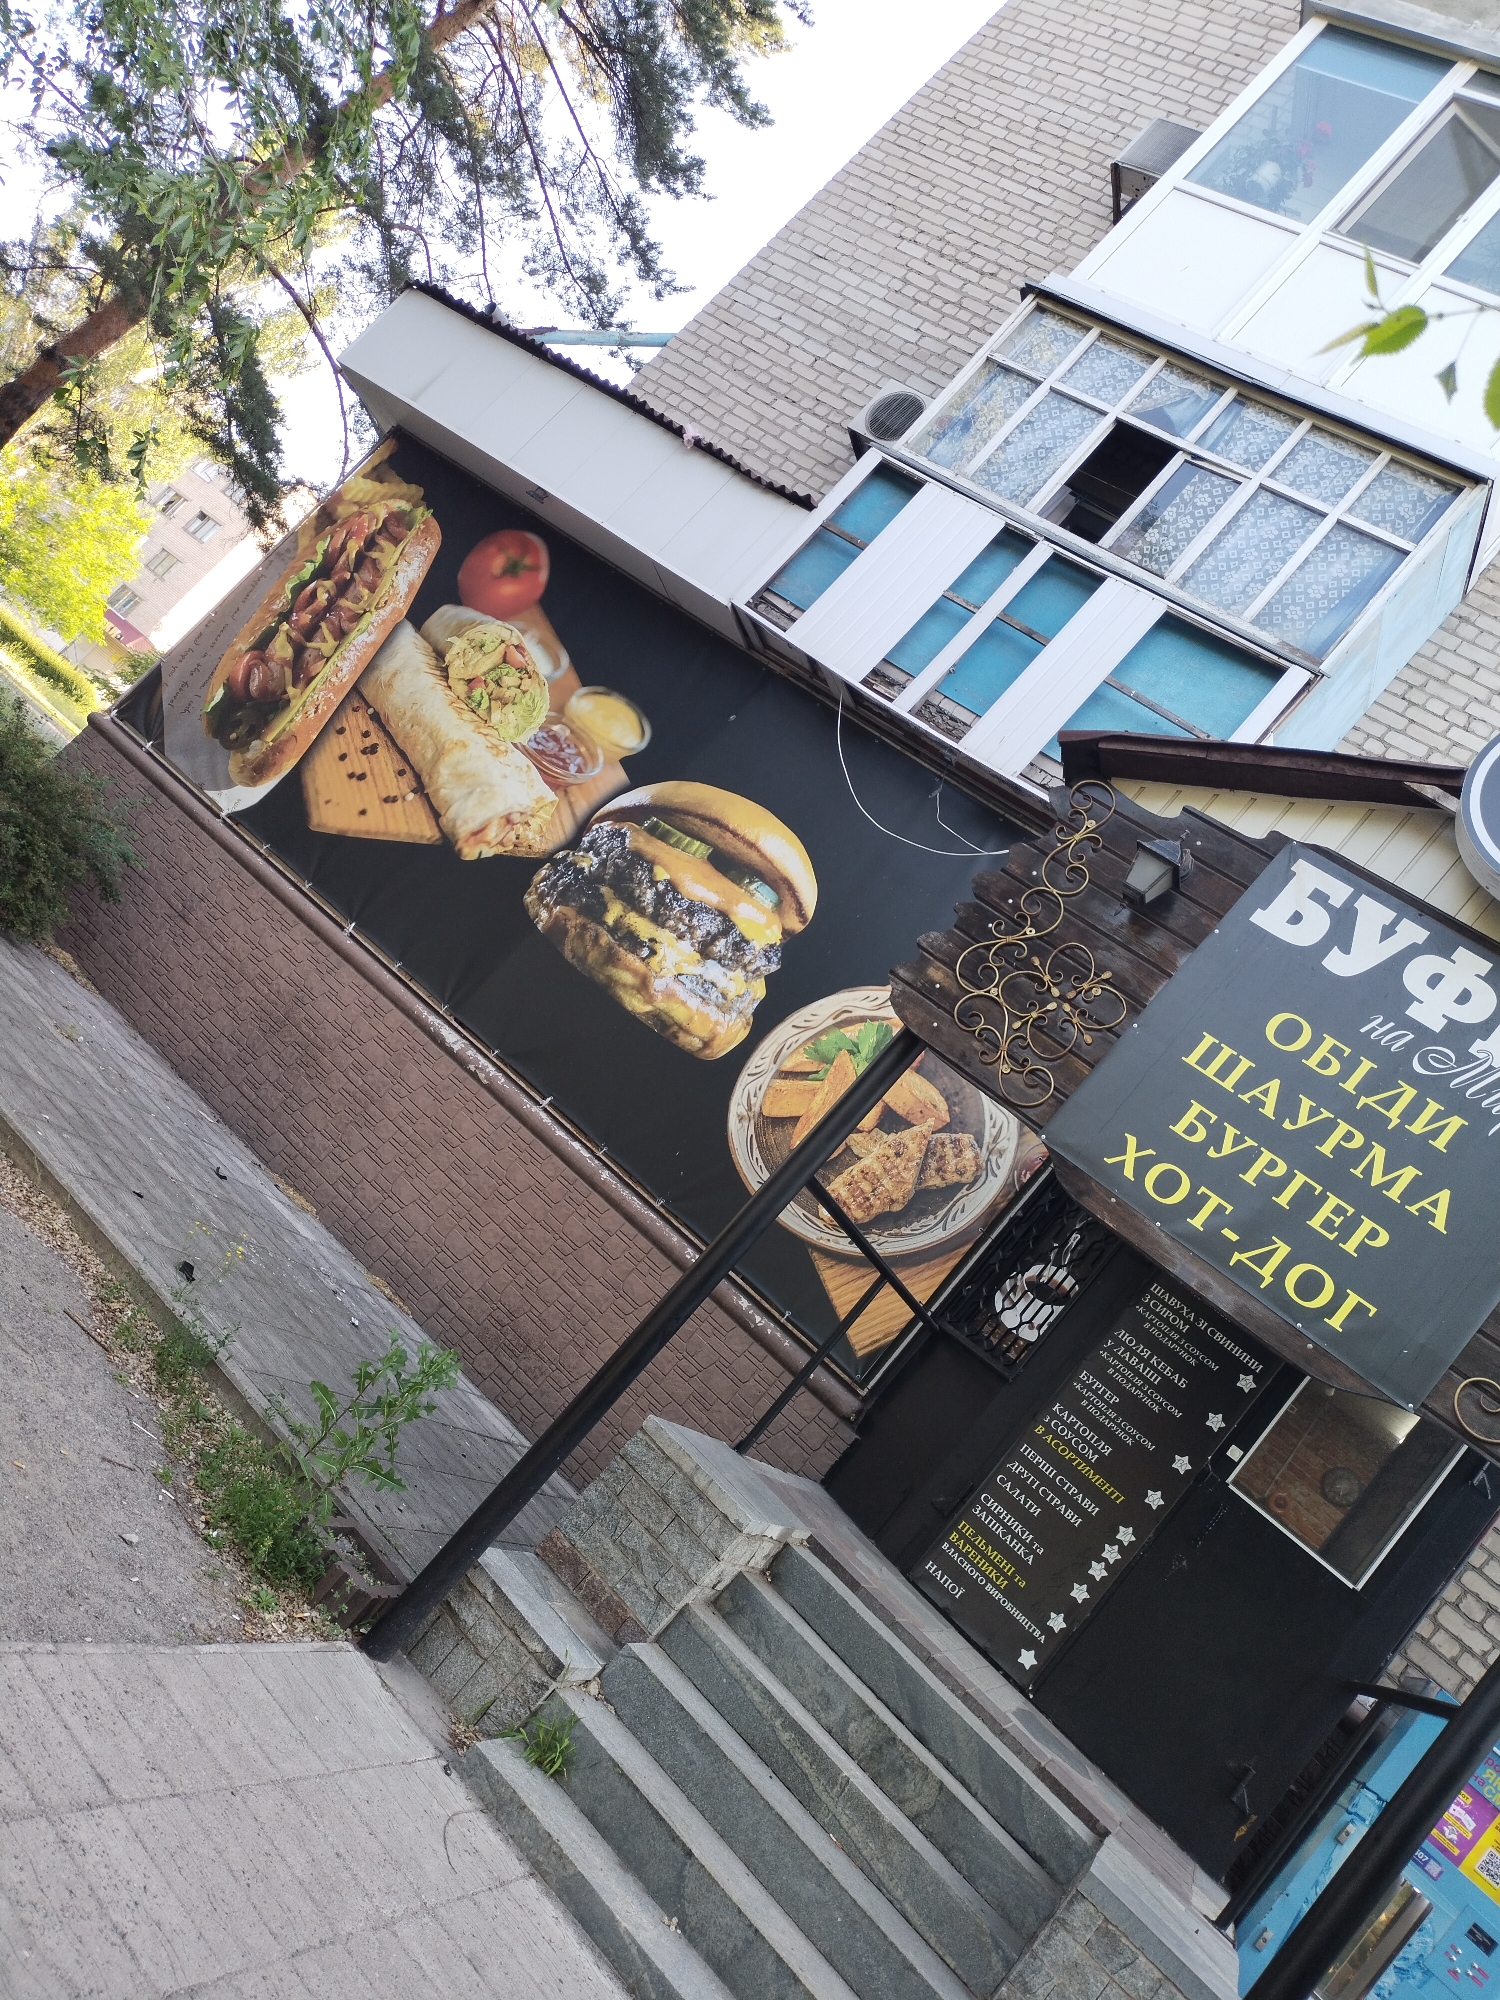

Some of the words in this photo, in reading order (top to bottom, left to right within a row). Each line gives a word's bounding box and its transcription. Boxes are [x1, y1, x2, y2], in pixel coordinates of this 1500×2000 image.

[228, 605, 243, 621] and
[240, 571, 267, 605] happiness
[191, 630, 206, 646] and
[208, 622, 230, 650] success
[1265, 1012, 1468, 1153] ОБІДИ
[1359, 1015, 1415, 1052] на
[1412, 1046, 1500, 1136] Ми
[1181, 1031, 1451, 1234] ШАУРМА
[1168, 1100, 1389, 1257] БУРГЕР
[1104, 1133, 1377, 1332] ХОТ-ДОГ
[1148, 1298, 1190, 1334] СИРОМ
[1149, 1282, 1196, 1322] ШАВУХА
[1194, 1316, 1208, 1330] ЗІ
[1206, 1326, 1266, 1375] СВИНИНИ
[1112, 1344, 1162, 1386] ЛАВАШІ
[1113, 1327, 1152, 1359] ЛЮЛЯ
[1148, 1354, 1188, 1389] КЕБАБ
[1148, 1326, 1198, 1367] ПОДАРУНОК
[1183, 1342, 1220, 1372] СОУСОМ
[1078, 1369, 1120, 1406] БУРГЕР
[1112, 1372, 1162, 1414] ПОДАРУНОК
[1146, 1388, 1183, 1418] СОУСОМ
[1048, 1418, 1100, 1464] СОУСОМ
[1050, 1402, 1114, 1456] КАРТОПЛЯ
[1085, 1404, 1136, 1446] ПОДАРУНОК
[1120, 1420, 1156, 1451] СОУСОМ
[1006, 1459, 1041, 1490] ДРУГІ
[1036, 1485, 1084, 1528] СТРАВИ
[1018, 1443, 1058, 1478] ПЕРШІ
[1054, 1474, 1101, 1516] СТРАВИ
[1040, 1432, 1127, 1505] АСОРТИМЕНТІ
[994, 1474, 1043, 1518] САЛАТИ
[970, 1504, 1035, 1566] ЗАПІКАНКА
[978, 1492, 1035, 1544] СИРНИКИ
[1031, 1540, 1044, 1556] та
[947, 1531, 1010, 1589] ВАРЕНИКИ
[956, 1520, 1017, 1577] ПЕЛЬМЕНІ
[1012, 1573, 1026, 1588] та
[922, 1560, 966, 1599] НАПОЇ
[941, 1541, 987, 1585] ВЛАСНОГО
[984, 1582, 1049, 1644] ВИРОБНИЦТВА
